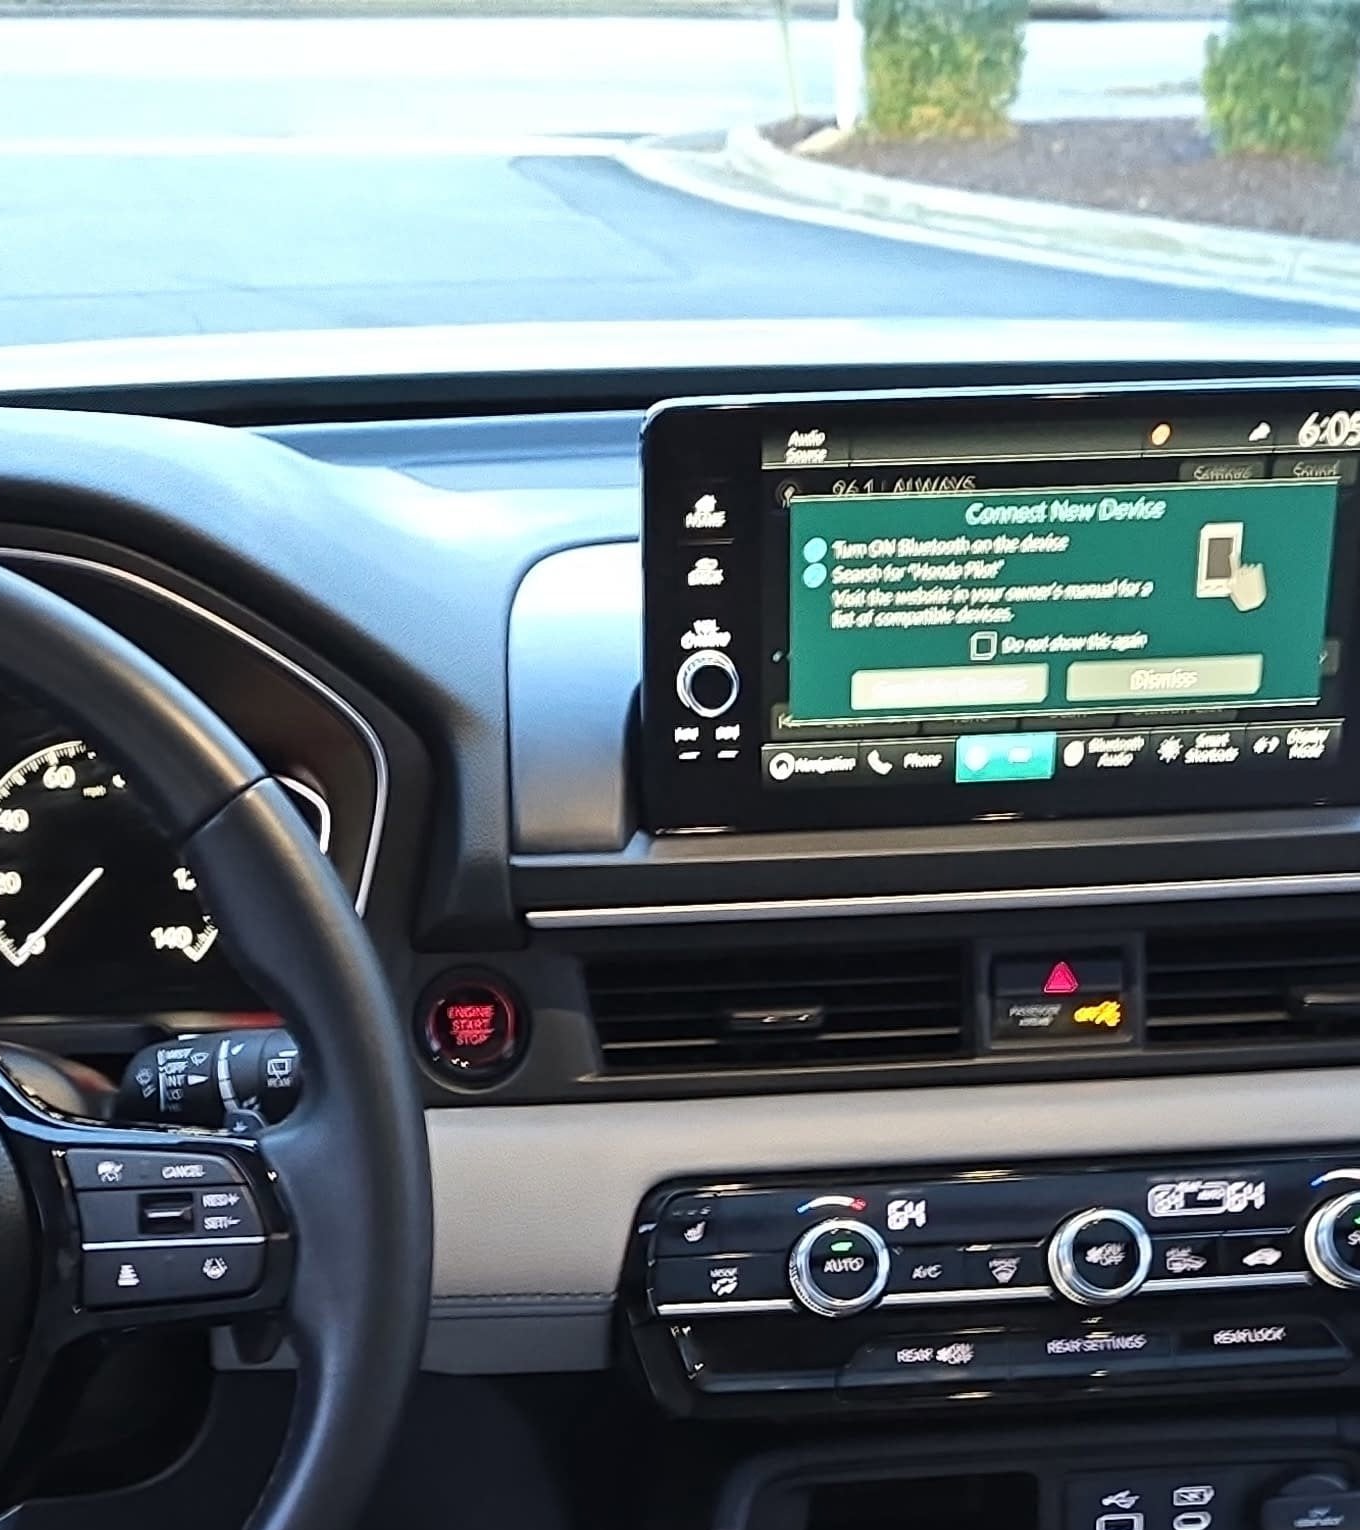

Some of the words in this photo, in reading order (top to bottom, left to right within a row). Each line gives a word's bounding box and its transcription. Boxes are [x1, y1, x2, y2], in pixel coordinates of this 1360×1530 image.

[966, 502, 1048, 525] Connect
[1050, 498, 1097, 522] New
[1099, 496, 1167, 520] Device
[831, 540, 867, 559] Turn
[868, 538, 896, 558] ON
[898, 536, 971, 557] Bluetooth
[971, 539, 992, 554] on
[993, 534, 1020, 553] the
[1020, 533, 1070, 552] device
[832, 564, 882, 584] Search
[883, 563, 906, 582] for
[832, 588, 866, 608] Visit
[867, 587, 893, 607] the
[895, 586, 952, 605] website
[970, 587, 1007, 605] your
[1064, 578, 1118, 600] manual
[832, 610, 855, 628] list
[855, 609, 874, 627] of
[874, 606, 955, 628] compatible
[1002, 636, 1024, 654] Do
[1025, 635, 1049, 652] not
[1050, 634, 1086, 651] show
[1130, 669, 1198, 691] Dismiss
[903, 752, 943, 769] Phone
[43, 764, 75, 789] 60
[151, 925, 193, 950] 140
[447, 1005, 494, 1019] ENGINE
[452, 1019, 491, 1031] START
[456, 1034, 490, 1045] STOP
[887, 1200, 926, 1230] 64
[823, 1257, 865, 1273] AUTO
[1047, 1338, 1081, 1354] REAR
[1081, 1334, 1147, 1352] SETTINGS
[1213, 1328, 1249, 1344] REAR
[1248, 1326, 1286, 1342] LOCK
[896, 1348, 934, 1363] REAR
